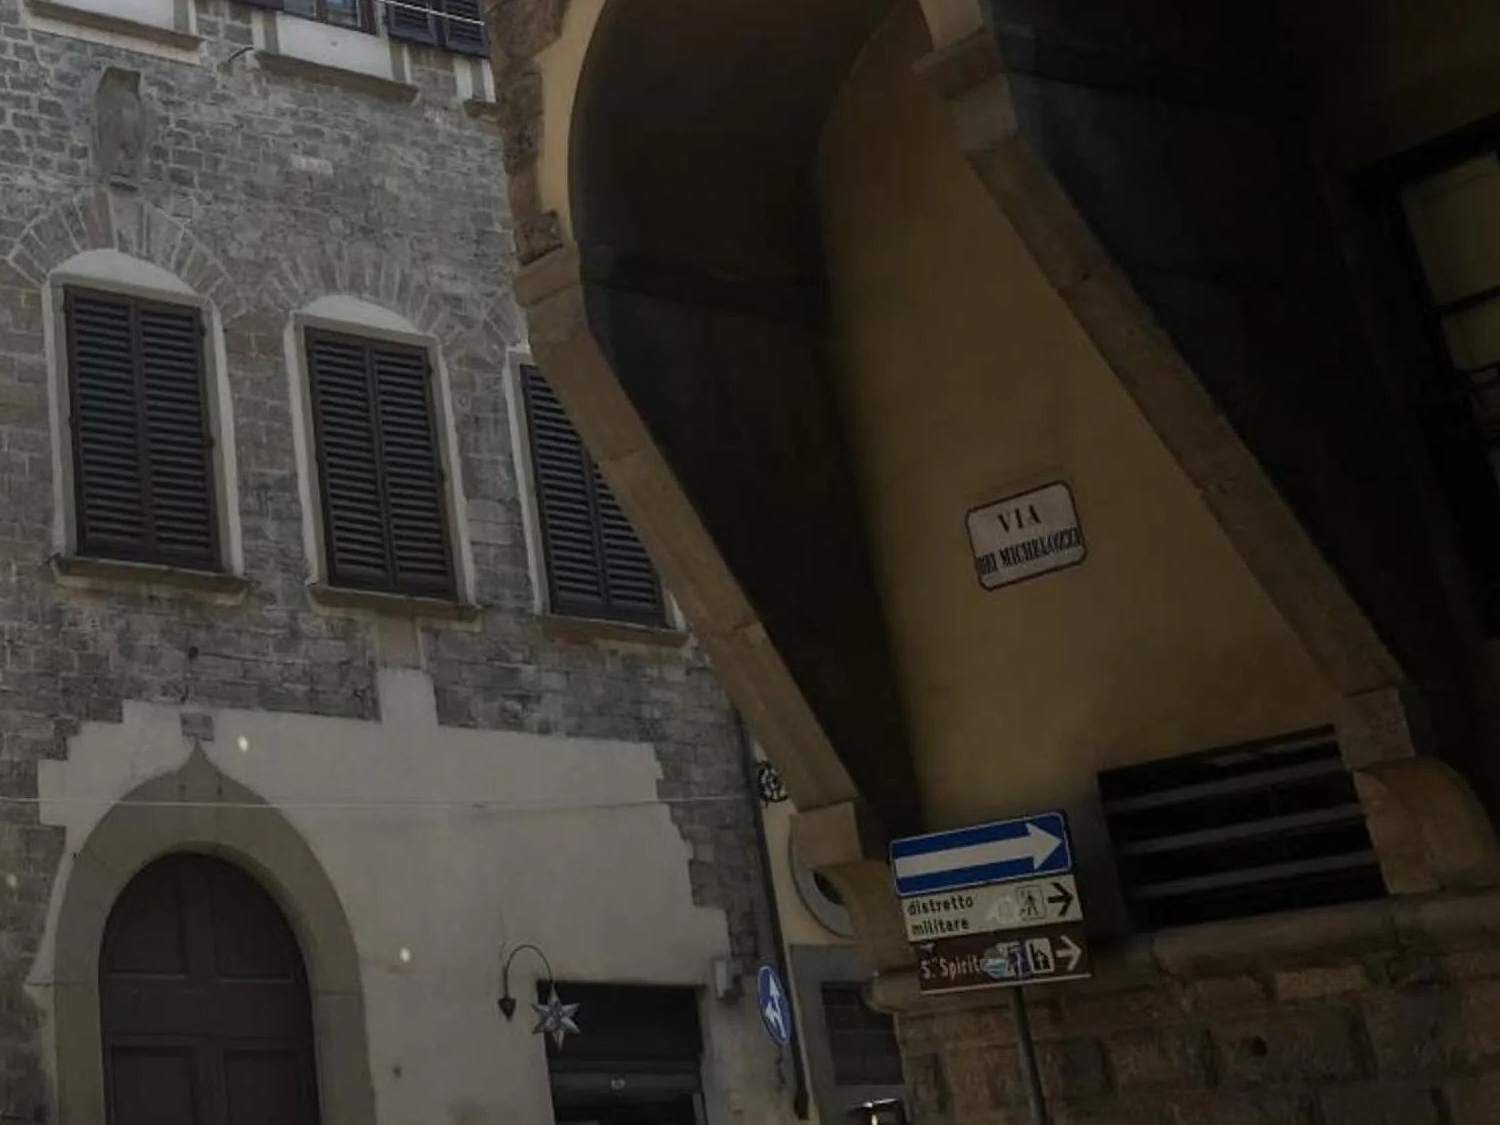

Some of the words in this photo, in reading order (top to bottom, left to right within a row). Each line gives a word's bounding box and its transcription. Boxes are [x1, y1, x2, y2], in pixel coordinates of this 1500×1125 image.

[997, 504, 1041, 533] VIA
[907, 897, 974, 916] distretto
[912, 917, 970, 936] militare
